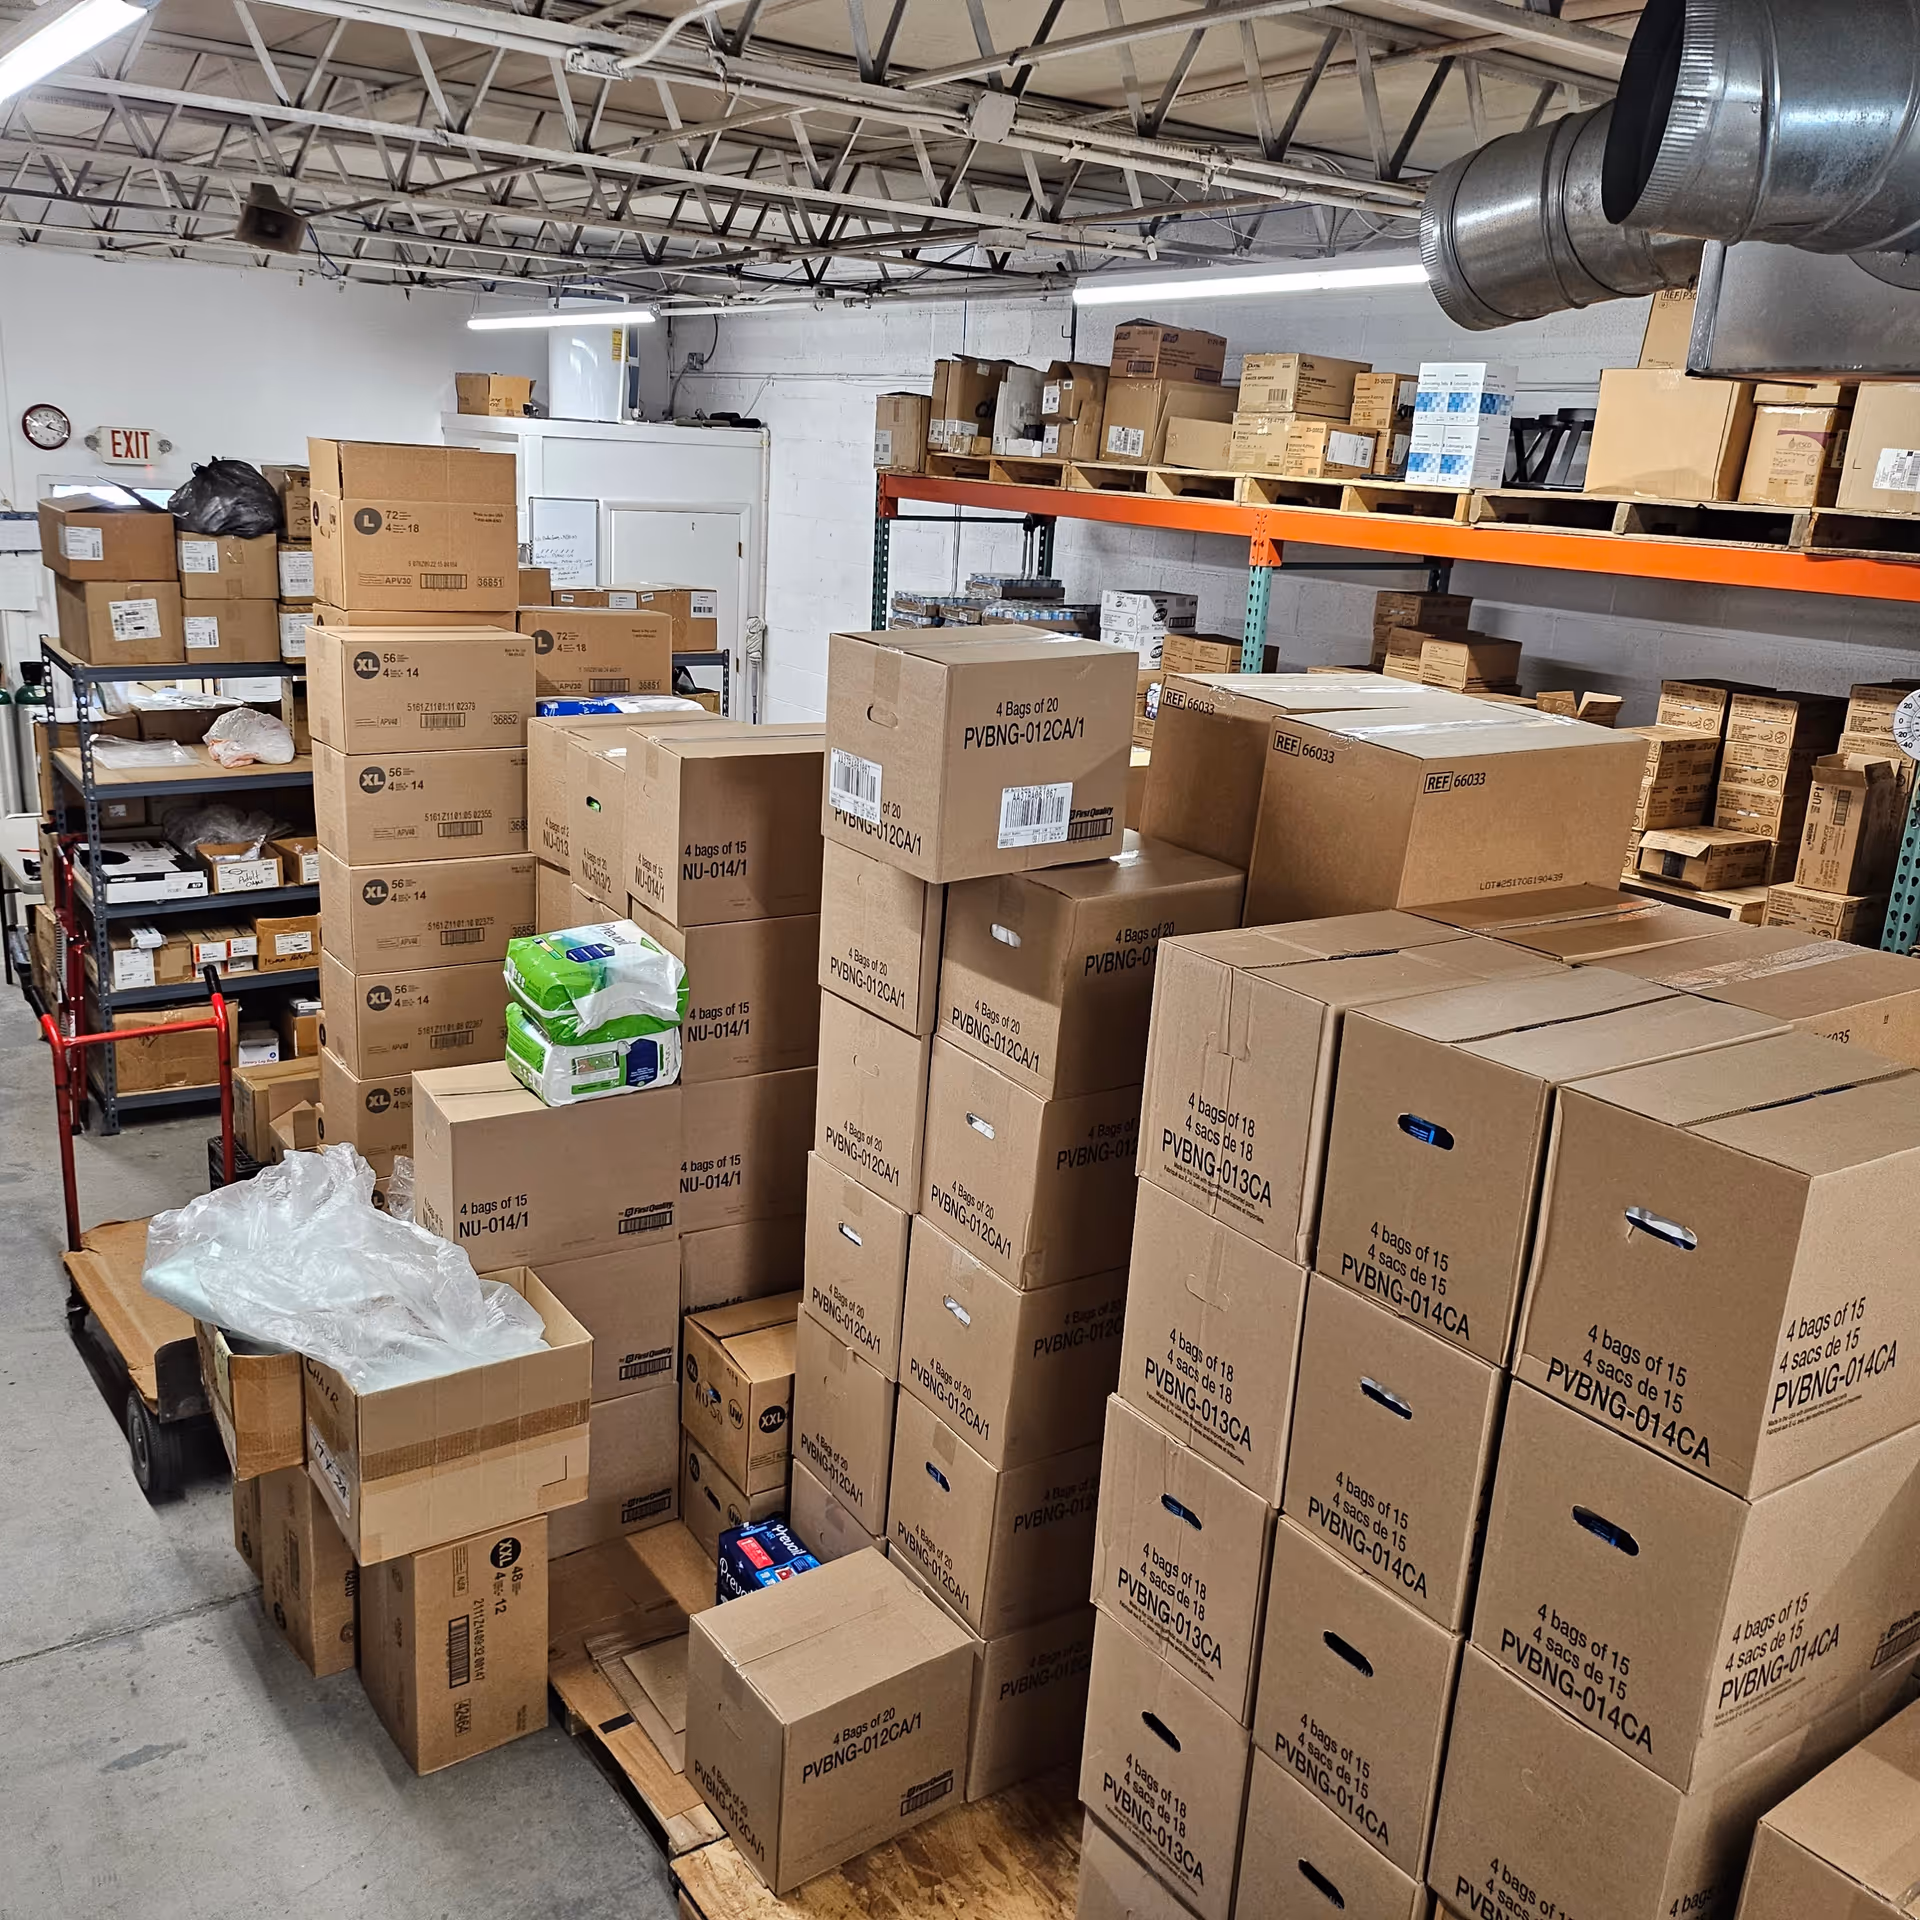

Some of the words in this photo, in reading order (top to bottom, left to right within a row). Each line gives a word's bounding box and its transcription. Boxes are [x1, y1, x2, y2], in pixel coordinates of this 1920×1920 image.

[111, 430, 150, 459] EXIT
[363, 514, 375, 527] L
[386, 510, 398, 520] 72
[385, 524, 391, 532] 4
[408, 524, 419, 533] 18
[385, 577, 411, 585] APV30
[478, 578, 503, 588] 36851
[537, 636, 548, 648] L
[557, 632, 568, 641] 72
[557, 645, 563, 653] 4
[576, 644, 587, 652] 18
[356, 659, 379, 672] XL
[383, 654, 396, 663] 56
[383, 669, 389, 677] 4
[406, 668, 419, 677] 14
[559, 682, 582, 690] APV30
[638, 681, 661, 690] 36851
[996, 703, 1004, 717] 4
[1005, 700, 1032, 719] Bags
[1034, 698, 1045, 714] of
[1046, 697, 1059, 713] 20
[1165, 691, 1184, 707] REF
[1187, 698, 1215, 716] 66033
[493, 715, 518, 724] 36852
[963, 717, 1085, 750] PVBNG-012CA/1
[1277, 733, 1298, 752] REF
[1302, 743, 1335, 764] 66033
[361, 773, 384, 787] XL
[389, 768, 402, 777] 56
[1427, 775, 1450, 790] REF
[1453, 772, 1486, 787] 66033
[388, 782, 394, 791] 4
[411, 781, 424, 790] 14
[1812, 792, 1823, 805] UP
[883, 801, 891, 815] of
[892, 803, 901, 819] 20
[1076, 809, 1089, 818] First
[1089, 807, 1113, 817] Quality
[685, 844, 692, 857] 4
[700, 843, 720, 859] bags
[721, 842, 732, 855] of
[735, 841, 747, 854] 15
[683, 859, 747, 880] NU-014/1
[365, 886, 387, 898] XL
[392, 879, 404, 888] 56
[634, 865, 664, 903] NU-014/1
[391, 893, 397, 902] 4
[413, 891, 427, 901] 14
[512, 925, 536, 937] 36852
[849, 948, 854, 960] 4
[854, 949, 871, 971] Bags
[871, 957, 880, 971] of
[879, 961, 888, 977] 20
[830, 956, 906, 1010] PVBNG-012CA/1
[1188, 1092, 1195, 1109] 4
[1198, 1096, 1226, 1123] bags
[1228, 1109, 1240, 1129] of
[1242, 1116, 1255, 1138] 18
[1185, 1115, 1192, 1131] 4
[1194, 1123, 1220, 1146] sacs
[1222, 1131, 1236, 1153] de
[1240, 1139, 1253, 1162] 18
[1162, 1128, 1272, 1208] PVBNG-013CA
[460, 1204, 468, 1216] 4
[471, 1201, 498, 1218] bags
[501, 1197, 512, 1211] of
[515, 1194, 528, 1209] 15
[634, 1204, 650, 1215] First
[650, 1201, 674, 1214] Quality
[459, 1211, 529, 1239] NU-014/1
[1786, 1320, 1796, 1343] 4
[1799, 1310, 1830, 1340] bags
[1833, 1304, 1849, 1328] of
[1850, 1296, 1866, 1321] 15
[1588, 1324, 1599, 1343] 4
[1602, 1328, 1641, 1364] bags
[1645, 1352, 1664, 1374] of
[1667, 1362, 1688, 1387] 15
[1779, 1351, 1790, 1374] 4
[1790, 1343, 1822, 1372] sacs
[1825, 1335, 1842, 1360] de
[1845, 1327, 1861, 1353] 15
[1583, 1349, 1593, 1368] 4
[1596, 1360, 1634, 1390] sacs
[1637, 1376, 1658, 1401] de
[1663, 1390, 1684, 1414] 15
[1771, 1339, 1898, 1415] PVBNG-014CA
[761, 1412, 785, 1429] XXL
[1546, 1357, 1711, 1468] PVBNG-014CA
[772, 1524, 807, 1557] Prevail
[499, 1539, 513, 1567] XXL
[495, 1572, 506, 1580] 4
[511, 1566, 524, 1582] 48
[495, 1598, 507, 1615] 12
[1537, 1604, 1548, 1622] 4
[1551, 1609, 1588, 1647] bags
[1591, 1641, 1609, 1661] of
[1612, 1651, 1631, 1676] 15
[1533, 1626, 1543, 1644] 4
[1546, 1638, 1581, 1671] sacs
[1584, 1662, 1604, 1685] de
[1609, 1675, 1628, 1701] 15
[1500, 1628, 1654, 1755] PVBNG-014CA
[833, 1733, 841, 1746] 4
[842, 1721, 868, 1742] Bags
[870, 1715, 882, 1728] of
[882, 1707, 896, 1723] 20
[803, 1712, 923, 1784] PVBNG-012CA/1
